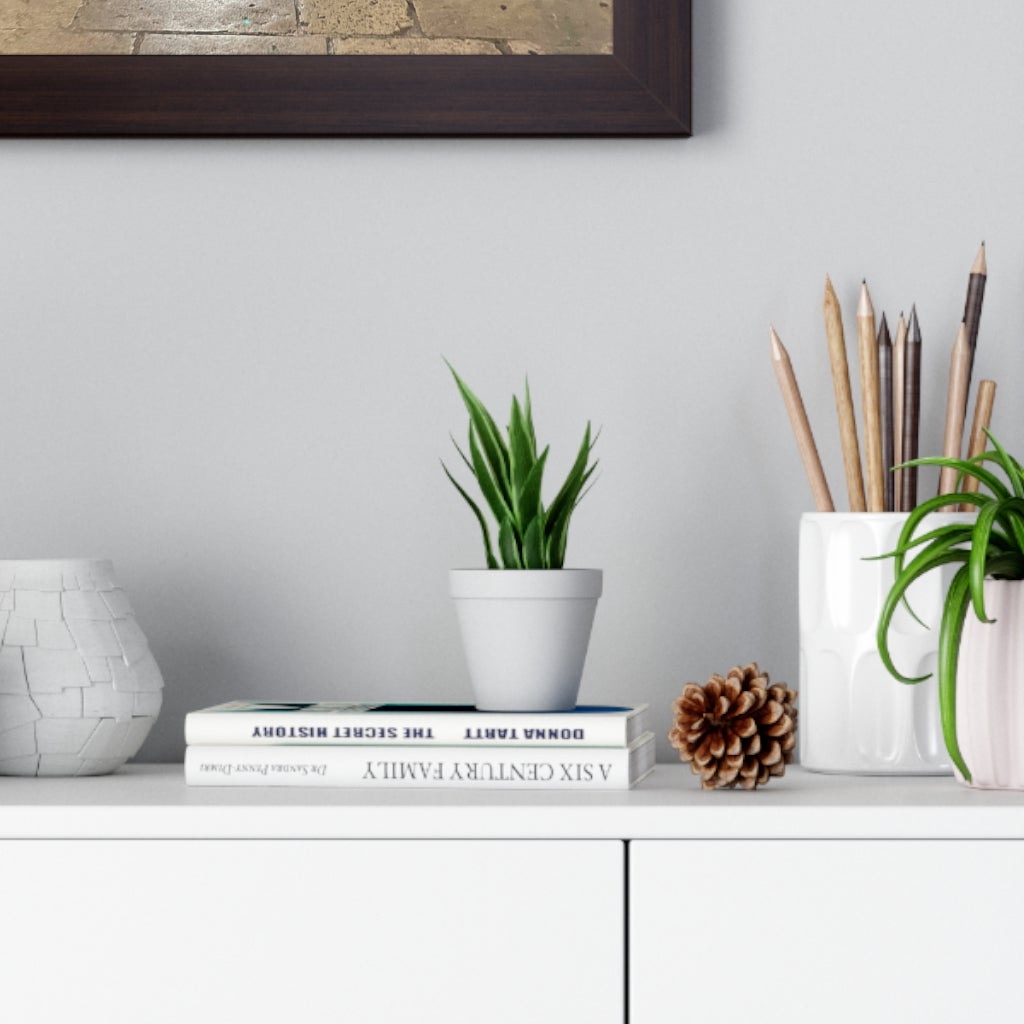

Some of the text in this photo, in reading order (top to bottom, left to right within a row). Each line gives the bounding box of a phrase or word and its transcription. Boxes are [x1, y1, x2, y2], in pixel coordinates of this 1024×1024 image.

[251, 726, 435, 739] THE SECRET HISTORY
[463, 728, 586, 740] DONNA TARTT
[361, 761, 613, 781] A SIX CENTURY FAMILY
